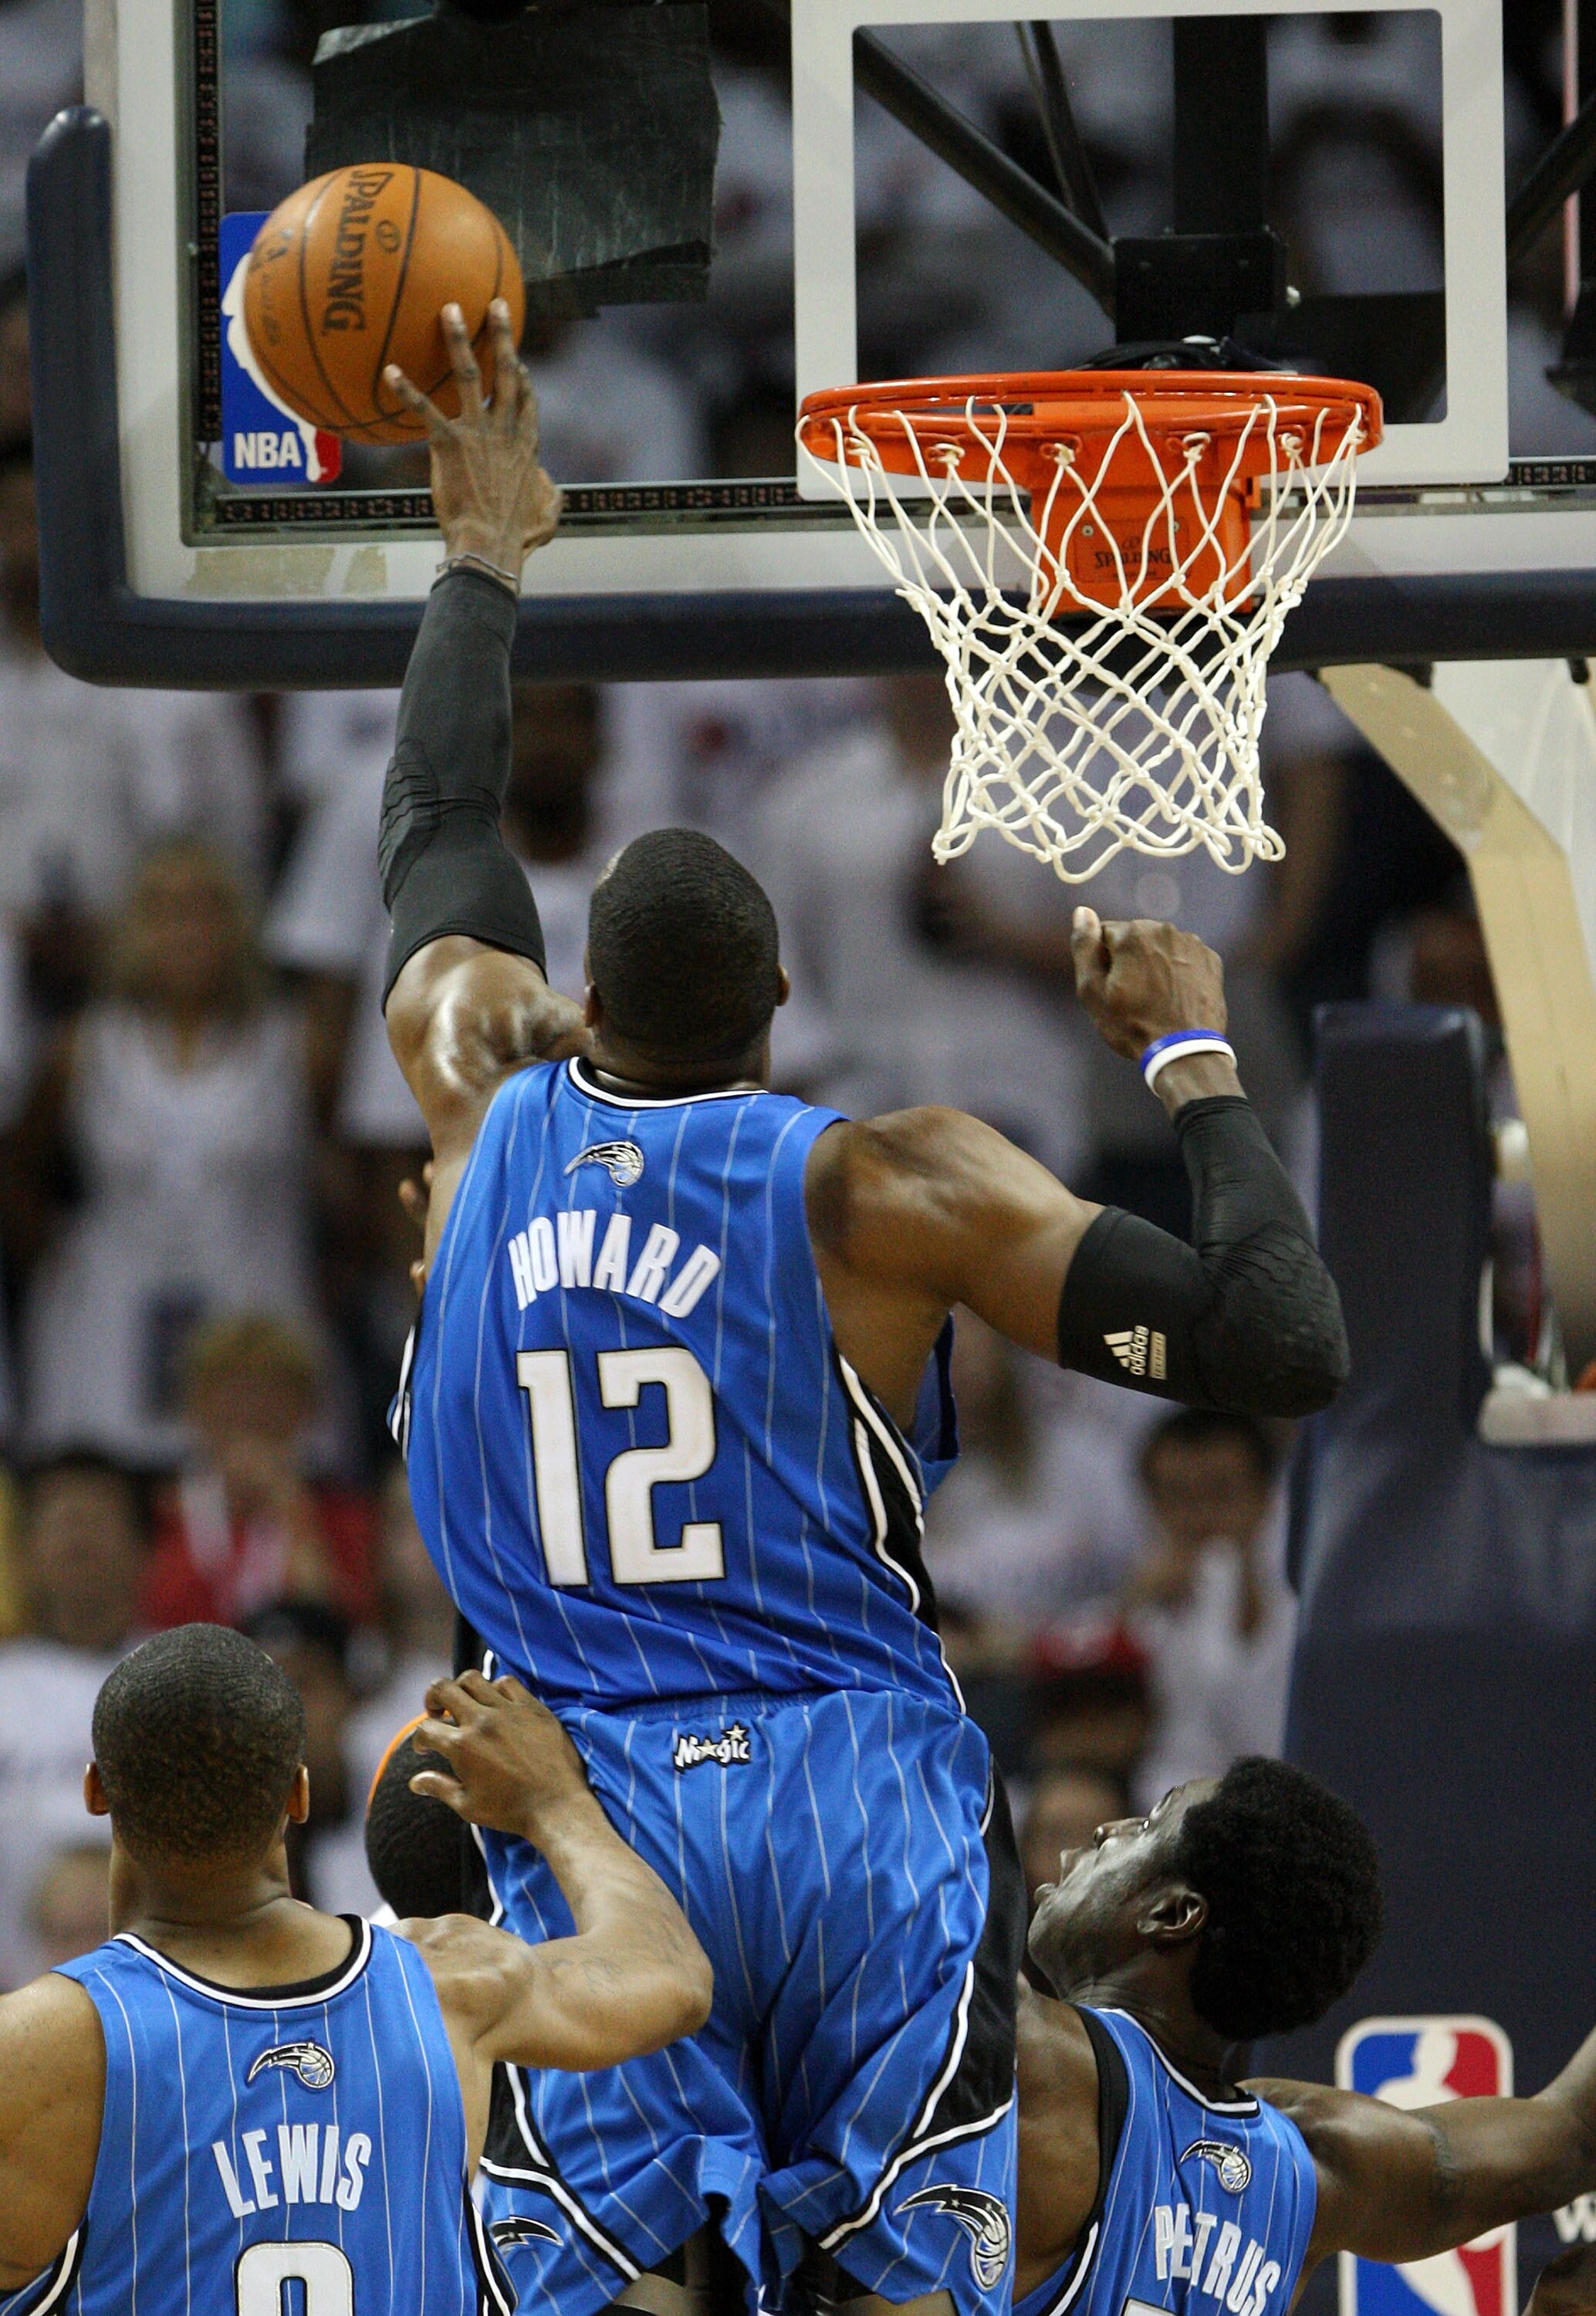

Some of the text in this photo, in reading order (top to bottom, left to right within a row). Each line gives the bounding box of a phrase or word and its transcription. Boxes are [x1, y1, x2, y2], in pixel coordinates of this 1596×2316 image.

[323, 169, 394, 331] SPALDING
[234, 431, 302, 469] NBA
[1094, 547, 1173, 569] SPLDNG
[508, 1209, 722, 1318] HOWARD
[1129, 1325, 1149, 1376] adidas
[516, 1346, 725, 1586] 12
[212, 2124, 372, 2219] LEWIS
[1155, 2203, 1281, 2316] PETRUS
